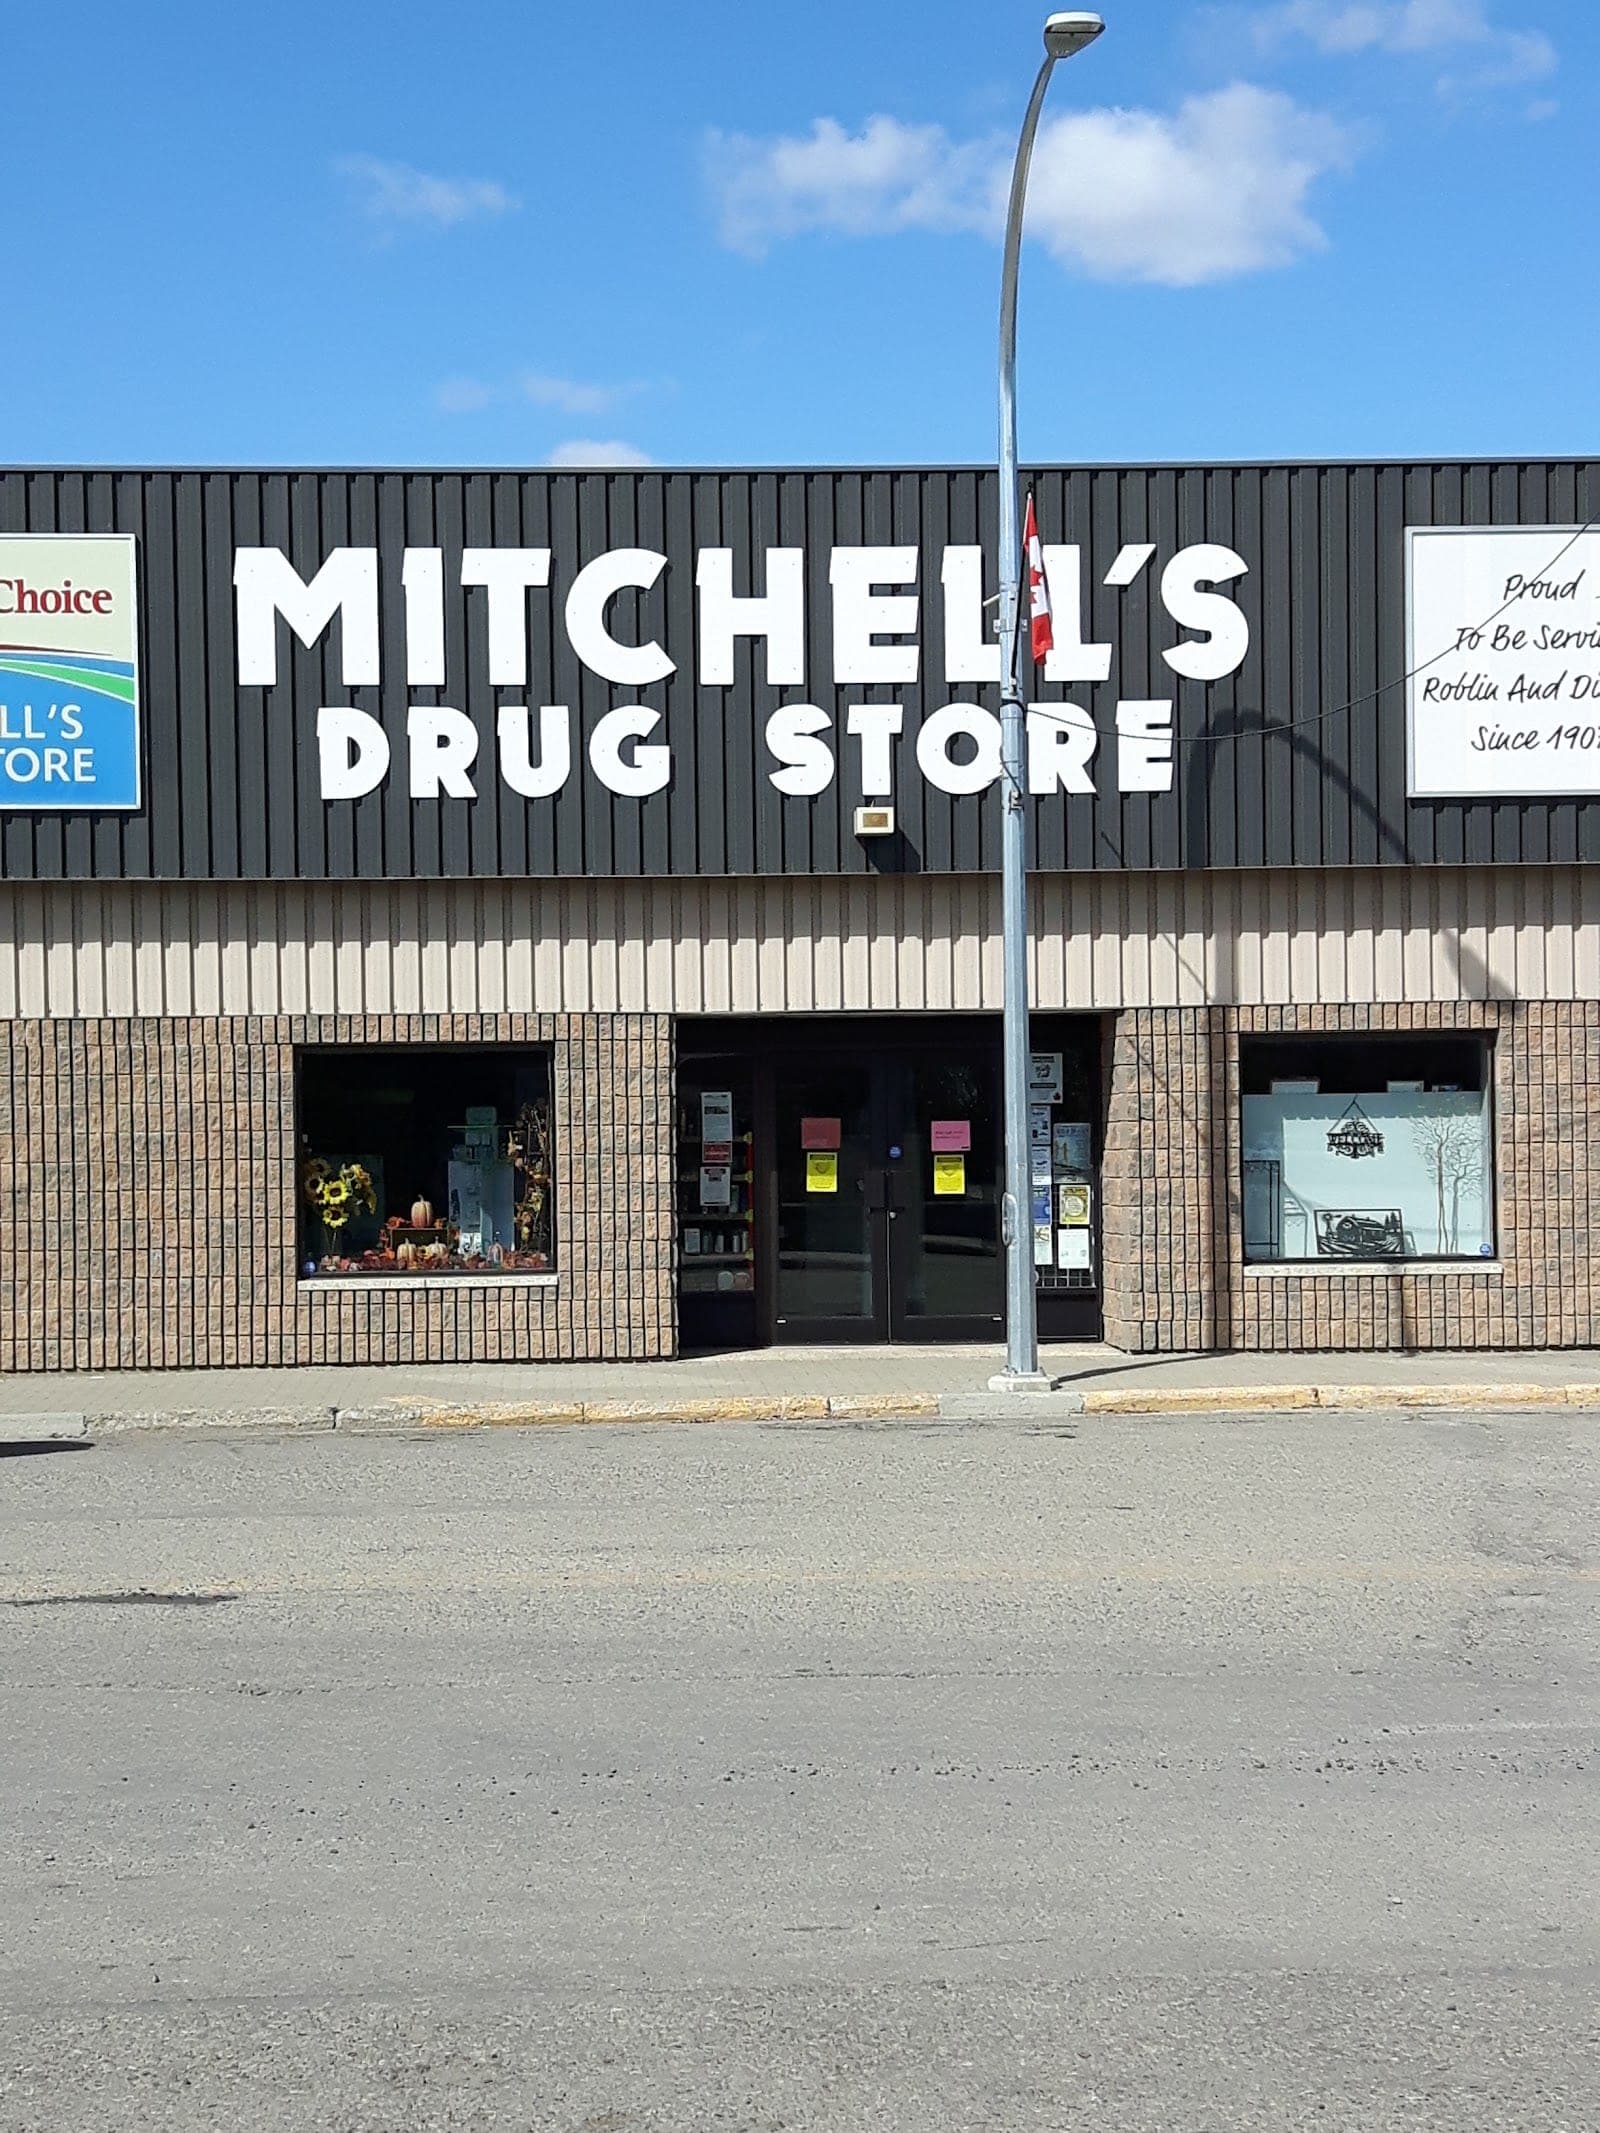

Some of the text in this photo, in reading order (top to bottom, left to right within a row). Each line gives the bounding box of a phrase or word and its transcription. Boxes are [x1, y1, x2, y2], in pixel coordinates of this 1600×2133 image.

[1504, 569, 1586, 601] Proud
[233, 543, 1250, 688] MITCHELL'S
[1456, 622, 1600, 651] To Be Servi
[1423, 671, 1499, 703] Roblin
[1508, 669, 1568, 703] And
[317, 699, 1174, 801] DRUG STORE
[1471, 723, 1540, 751] Since
[0, 747, 97, 783] ORE
